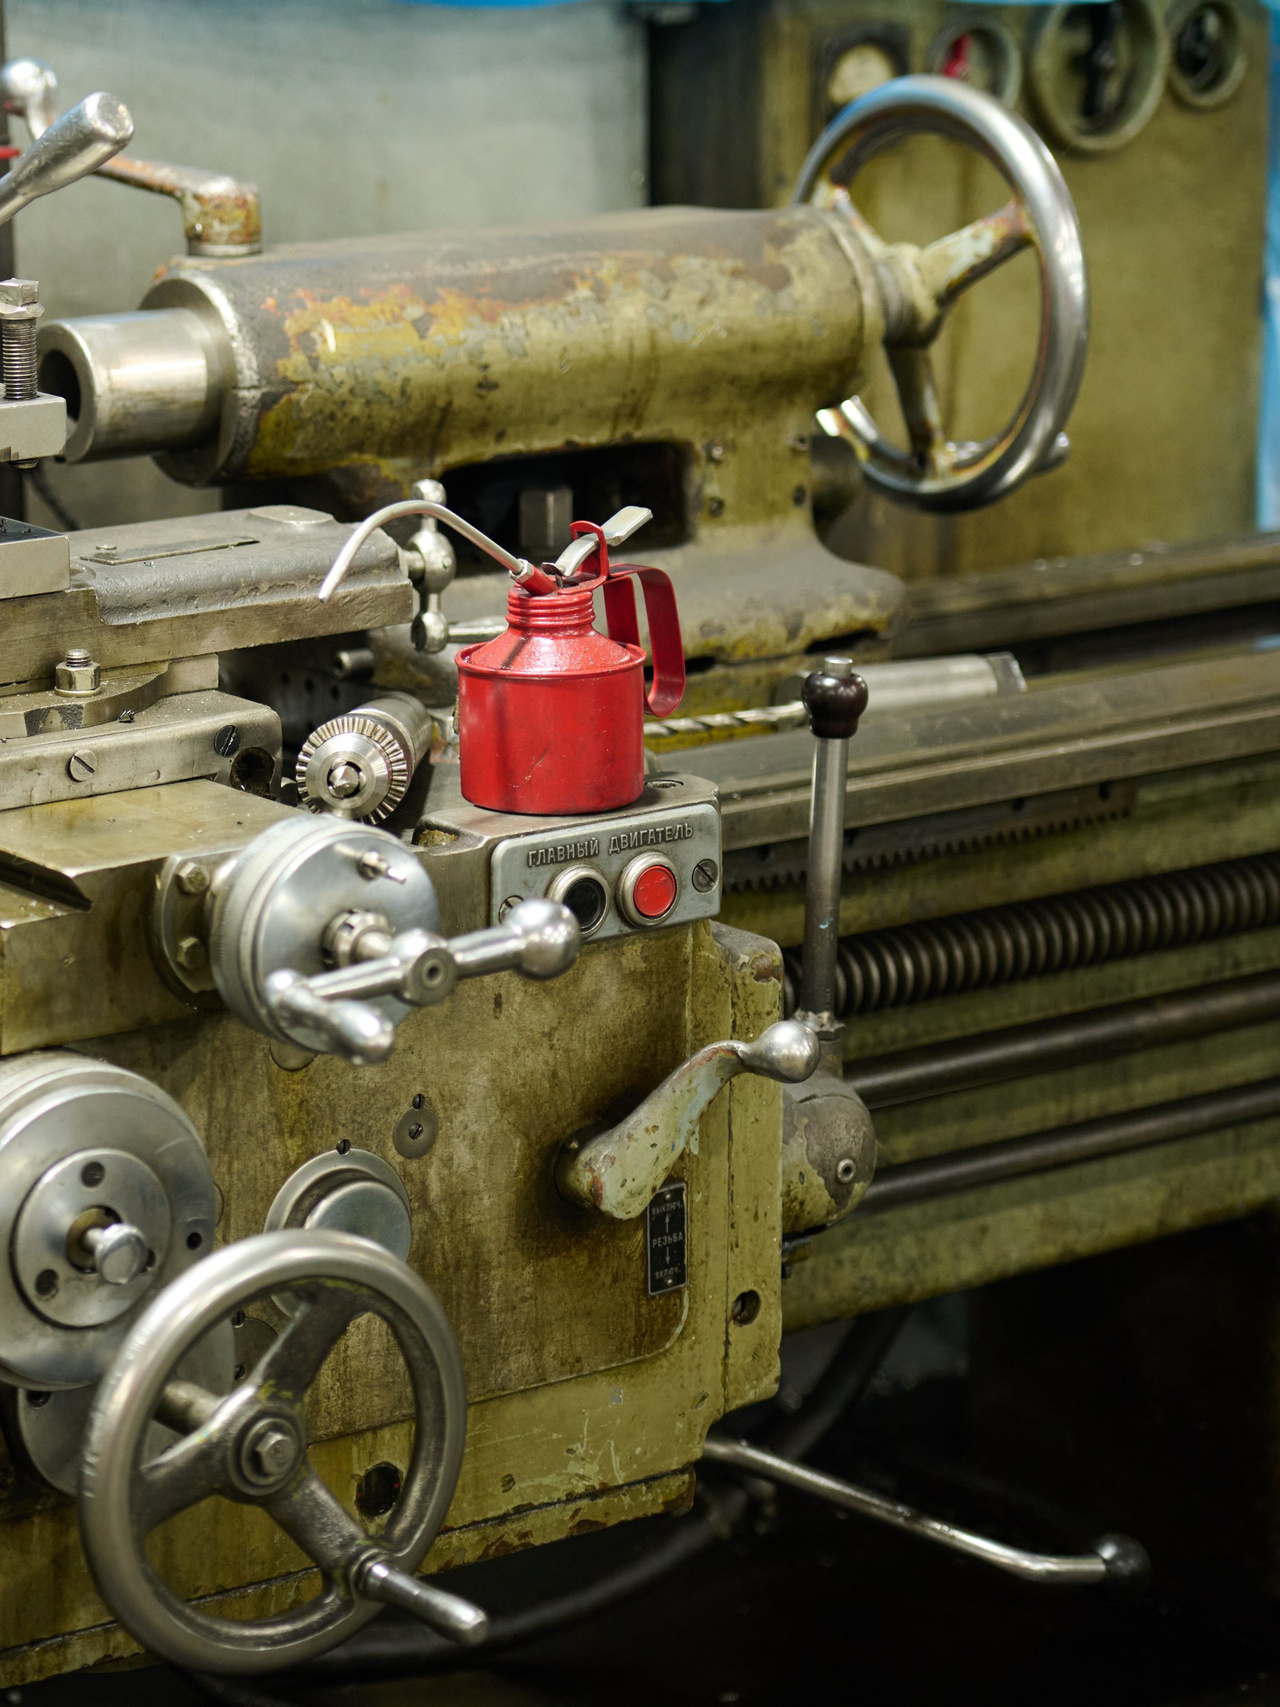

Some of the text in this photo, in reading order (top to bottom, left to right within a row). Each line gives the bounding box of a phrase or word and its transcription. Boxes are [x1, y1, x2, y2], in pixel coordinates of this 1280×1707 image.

[528, 823, 693, 867] ГЛАВНЫЙ ДВИГАТЕЛЬ
[652, 1231, 684, 1249] РЕЗЬБА
